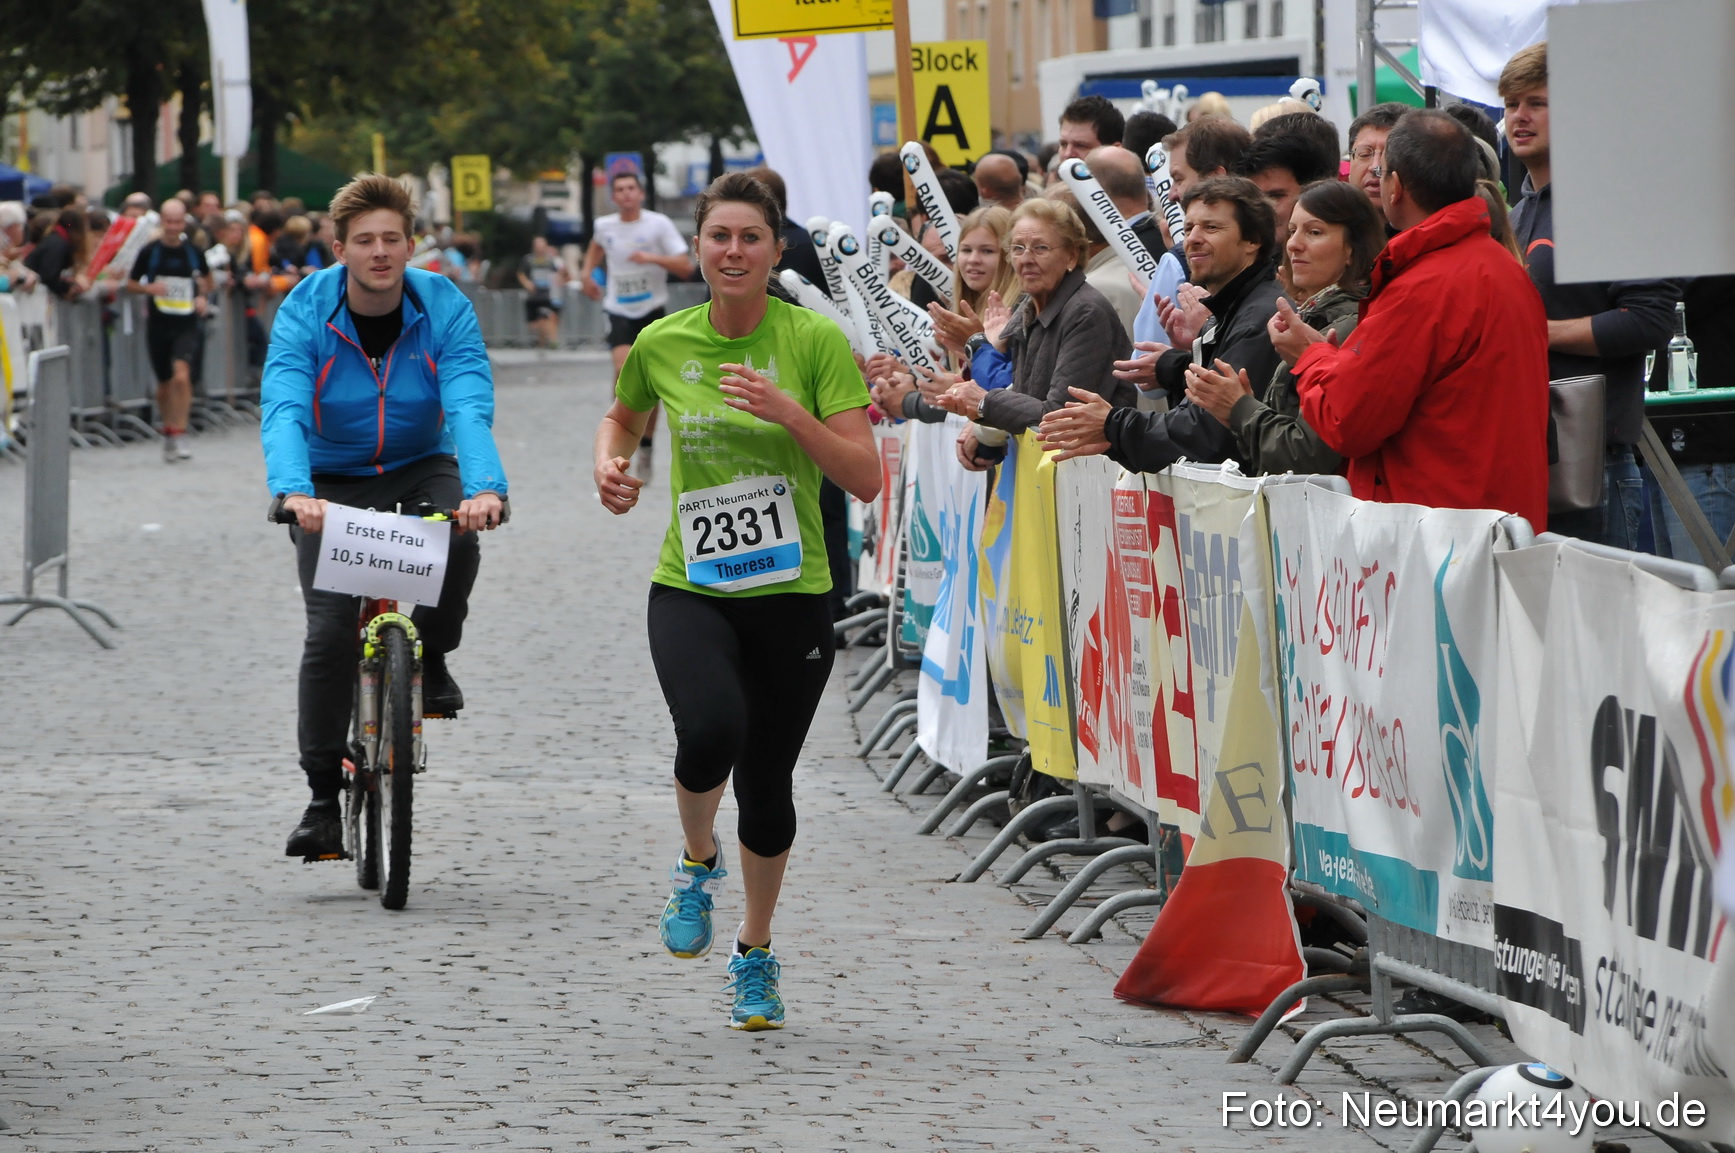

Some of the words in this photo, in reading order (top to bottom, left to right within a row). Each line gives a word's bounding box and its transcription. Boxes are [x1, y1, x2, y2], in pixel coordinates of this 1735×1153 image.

[911, 47, 978, 72] Block
[921, 84, 971, 150] A
[462, 172, 482, 197] D
[917, 182, 948, 229] BMW
[820, 256, 847, 295] BMW
[899, 246, 939, 281] BMW
[855, 262, 896, 310] BMW
[679, 498, 714, 514] PARTL
[716, 488, 770, 507] Neumarkt
[346, 521, 385, 541] Erste
[390, 530, 425, 548] Frau
[692, 501, 784, 556] 2331
[330, 548, 364, 566] 10,5
[369, 553, 393, 571] km
[398, 559, 434, 577] Lauf
[714, 556, 776, 579] Theresa
